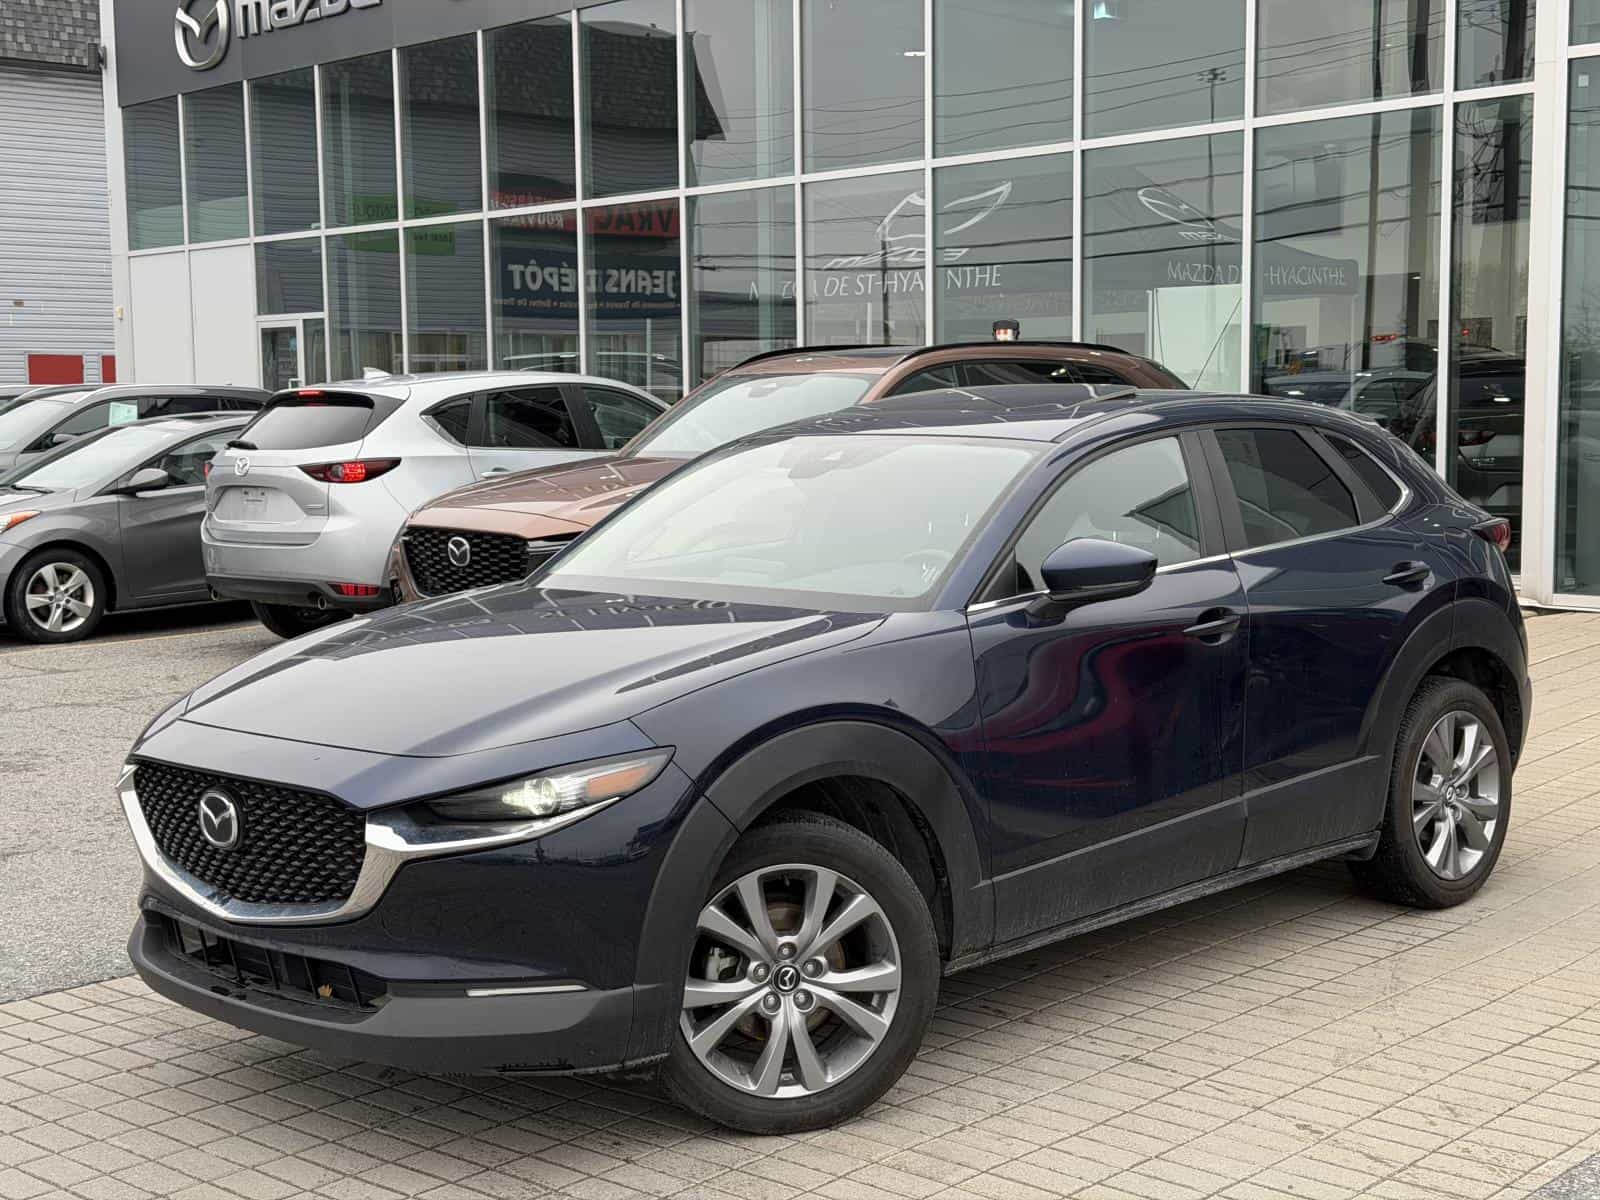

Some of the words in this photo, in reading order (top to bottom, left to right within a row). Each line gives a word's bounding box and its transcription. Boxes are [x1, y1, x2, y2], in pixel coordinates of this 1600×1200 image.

[823, 276, 849, 297] DE
[855, 264, 1001, 295] ST-HYANTHE
[1167, 260, 1224, 283] MAZDA
